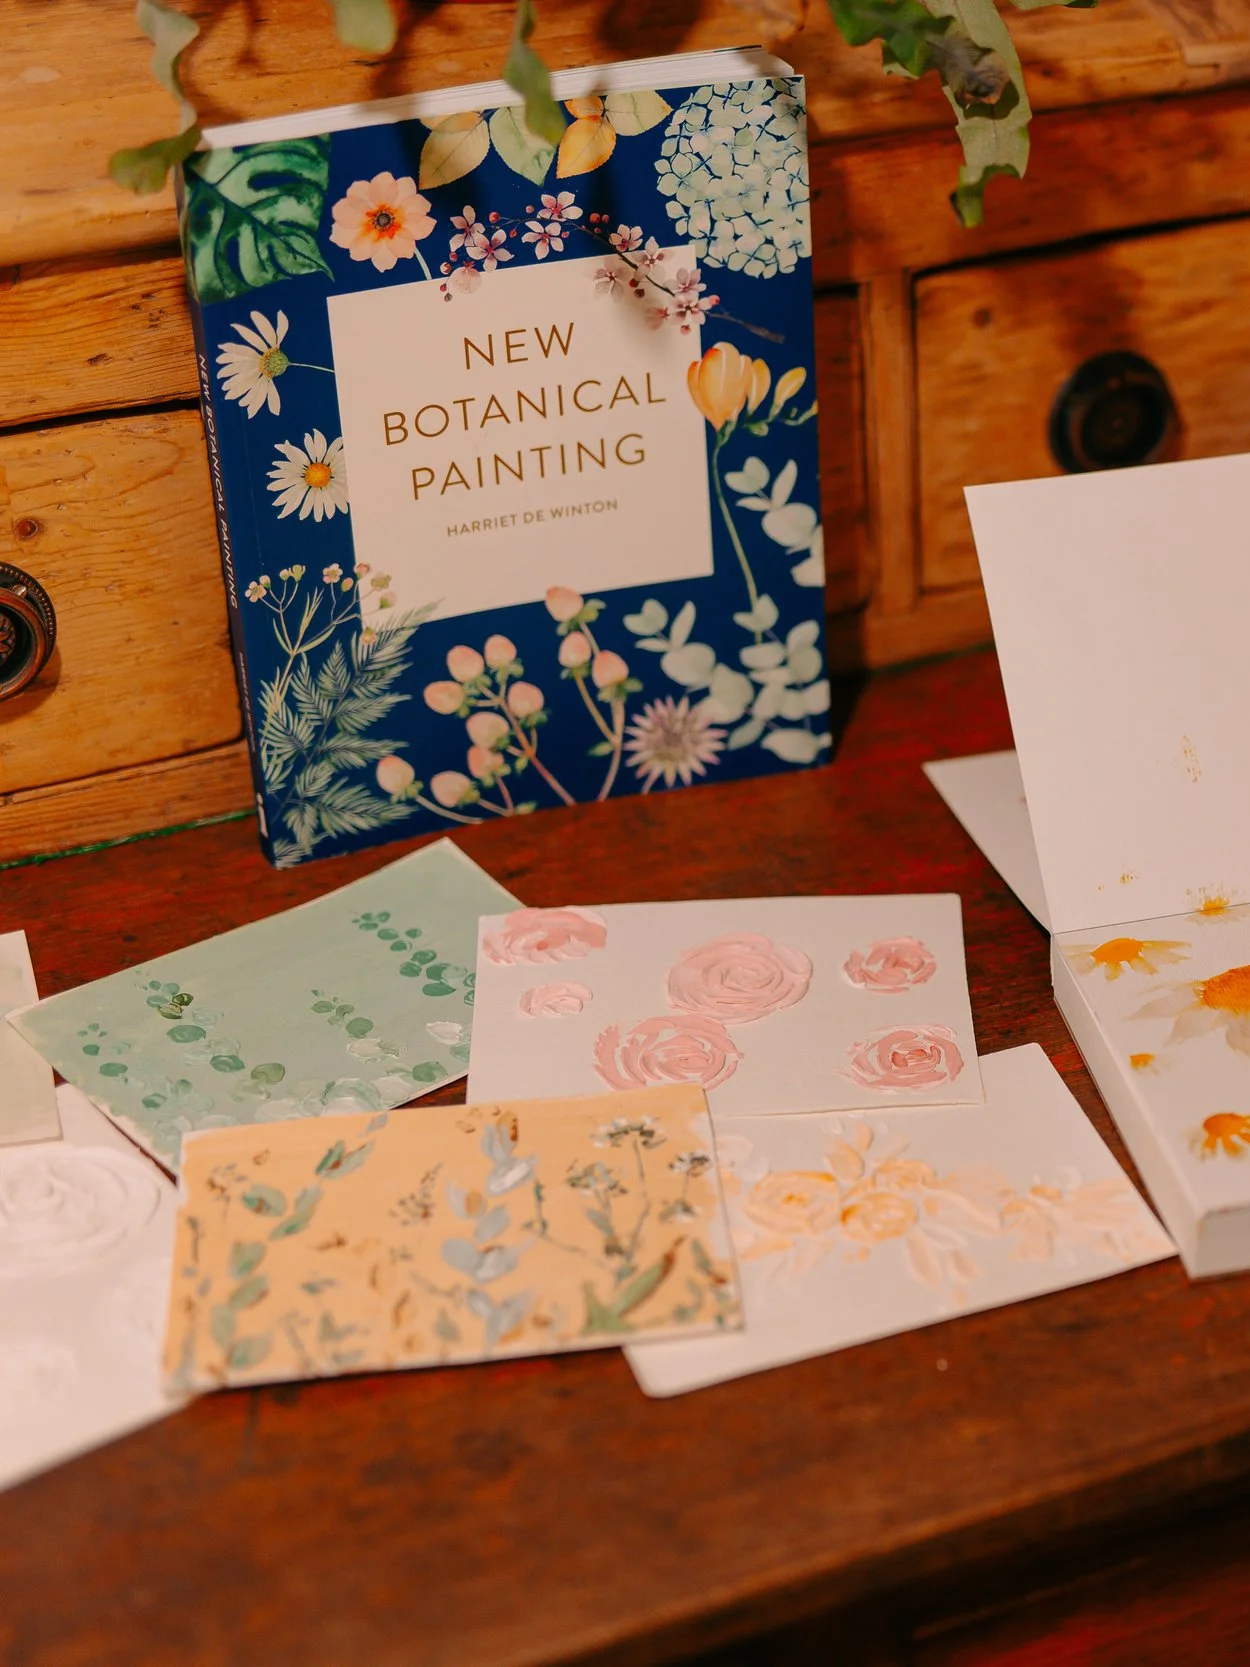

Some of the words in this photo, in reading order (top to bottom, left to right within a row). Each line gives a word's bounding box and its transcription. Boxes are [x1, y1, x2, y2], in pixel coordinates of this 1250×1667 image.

[199, 354, 212, 401] NEW
[463, 322, 574, 370] NEW
[383, 372, 667, 446] BOTANICAL
[205, 404, 225, 512] BOTANICAL
[412, 433, 645, 501] PAINTING
[447, 514, 518, 538] HARRIET
[523, 510, 546, 525] DE
[549, 499, 619, 519] WINTON
[221, 518, 238, 609] PAINTING
